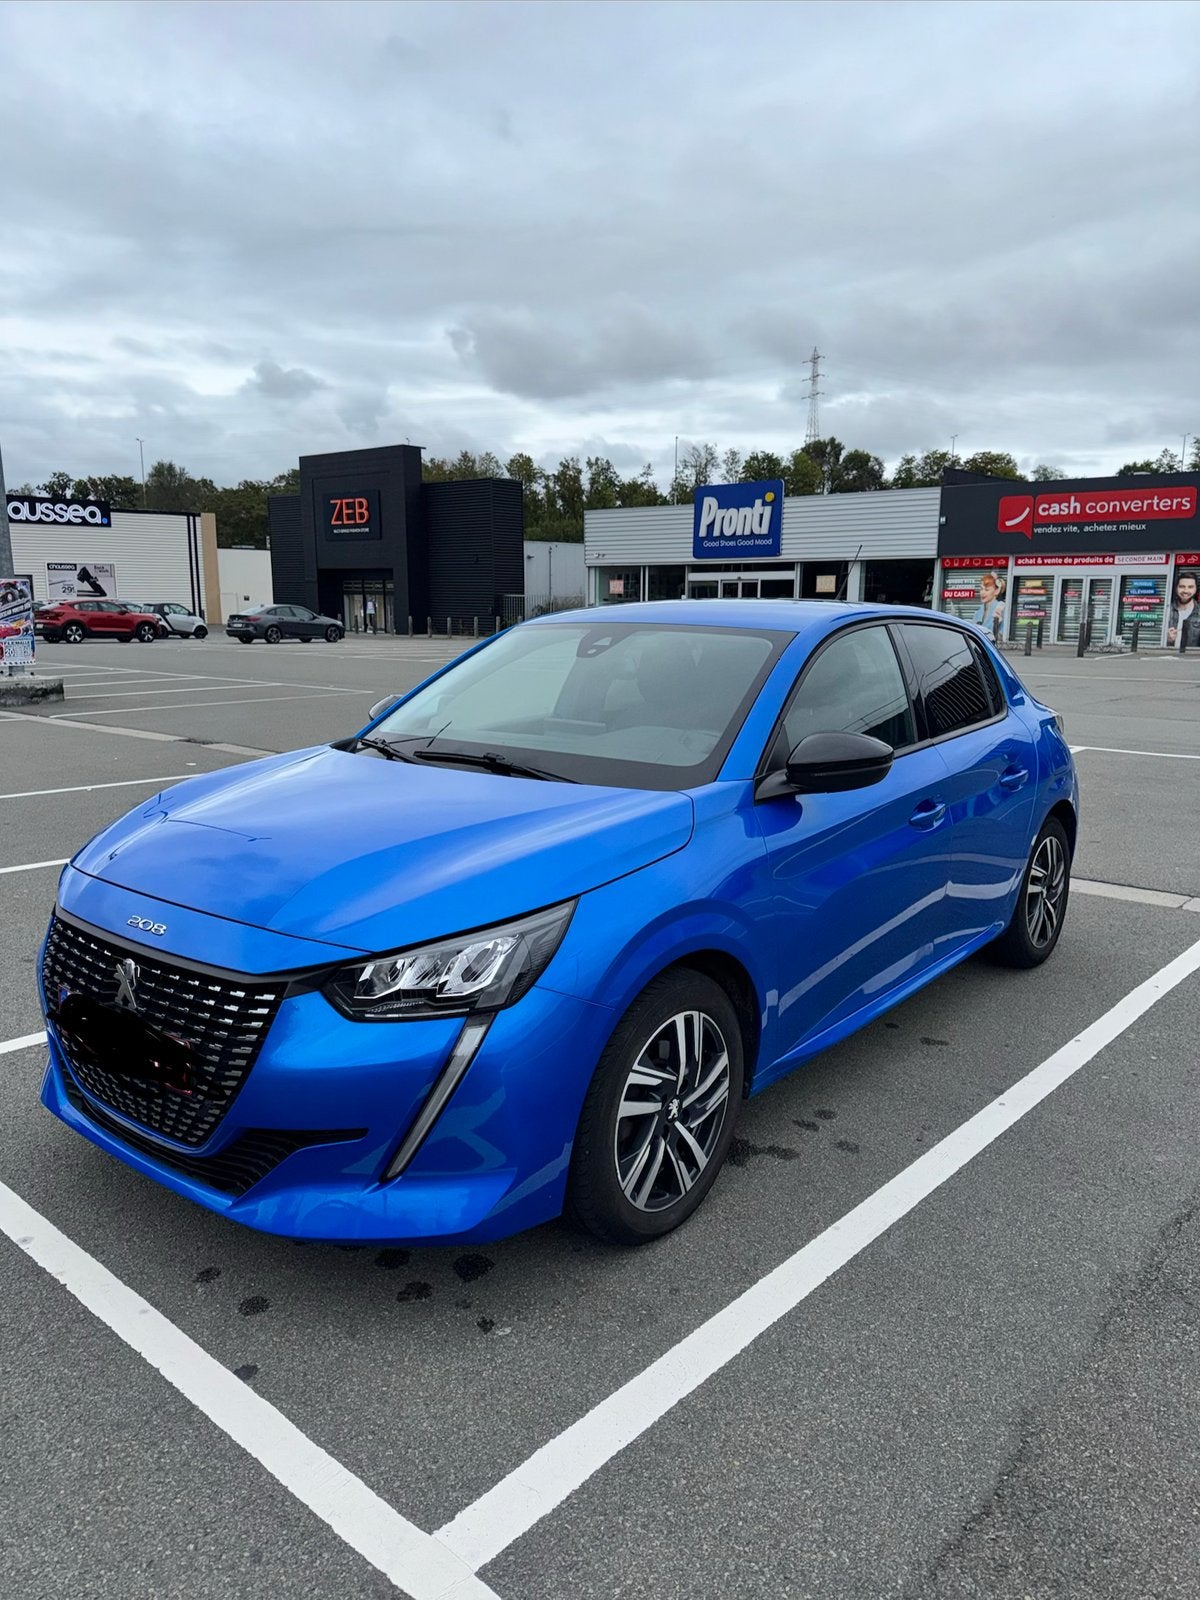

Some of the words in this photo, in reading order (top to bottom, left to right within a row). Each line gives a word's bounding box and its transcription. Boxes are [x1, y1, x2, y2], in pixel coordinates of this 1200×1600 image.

[330, 497, 370, 525] ZEB
[699, 491, 775, 538] Pronti
[1038, 496, 1081, 516] cash
[1085, 495, 1191, 514] converters
[1033, 525, 1062, 534] vendez
[1063, 524, 1080, 533] vite,
[1083, 523, 1116, 532] achetez
[1119, 523, 1146, 531] mieux
[755, 538, 773, 546] Mood
[1017, 557, 1036, 565] achat
[1063, 556, 1073, 564] de
[1073, 556, 1103, 565] produits
[1104, 555, 1114, 563] de
[127, 915, 167, 935] 208
